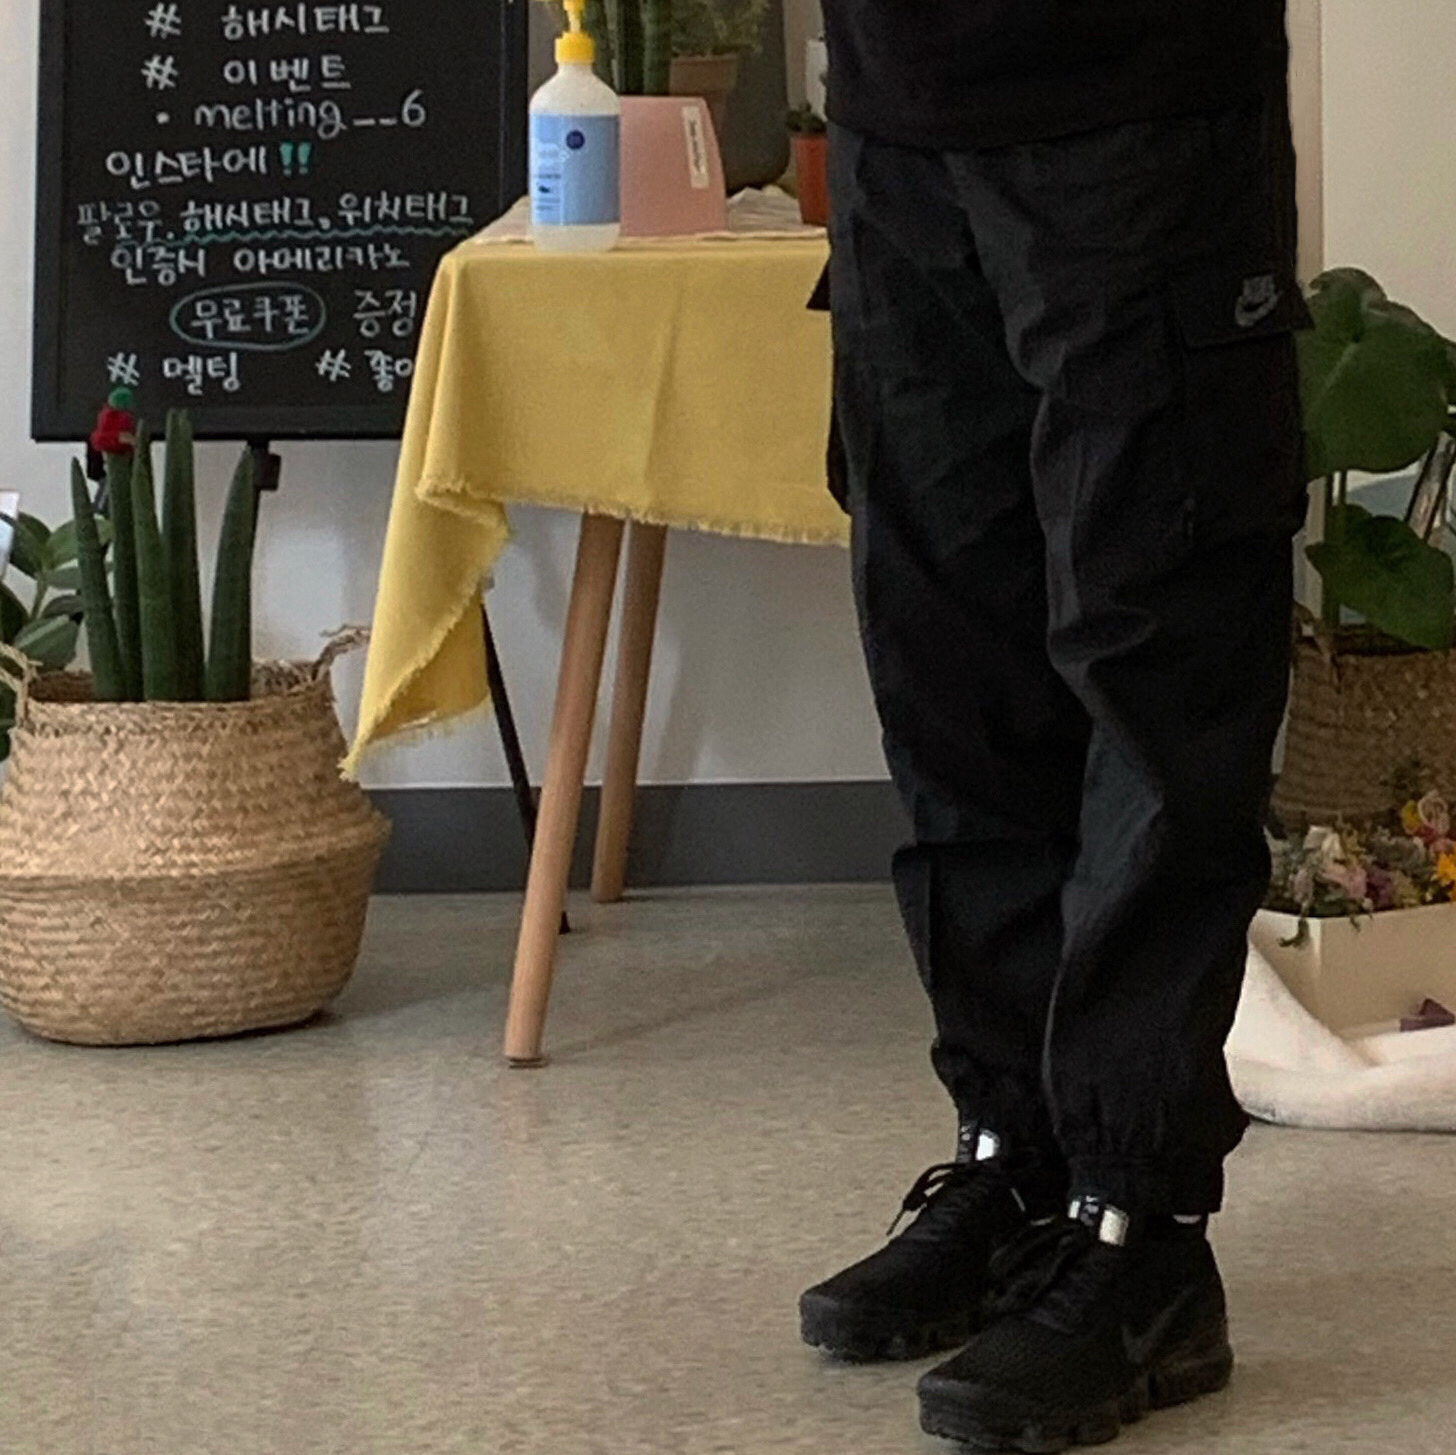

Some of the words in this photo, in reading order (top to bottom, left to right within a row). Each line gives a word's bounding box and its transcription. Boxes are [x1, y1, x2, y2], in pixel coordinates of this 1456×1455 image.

[220, 3, 390, 40] 해시태그
[223, 55, 351, 92] 이벤트
[338, 191, 474, 227] 위치태그
[110, 246, 206, 286] 인증시
[233, 244, 410, 275] 아메리카노
[191, 295, 310, 340] 무료쿠폰
[353, 290, 417, 338] 증정
[162, 351, 241, 395] 멜팅
